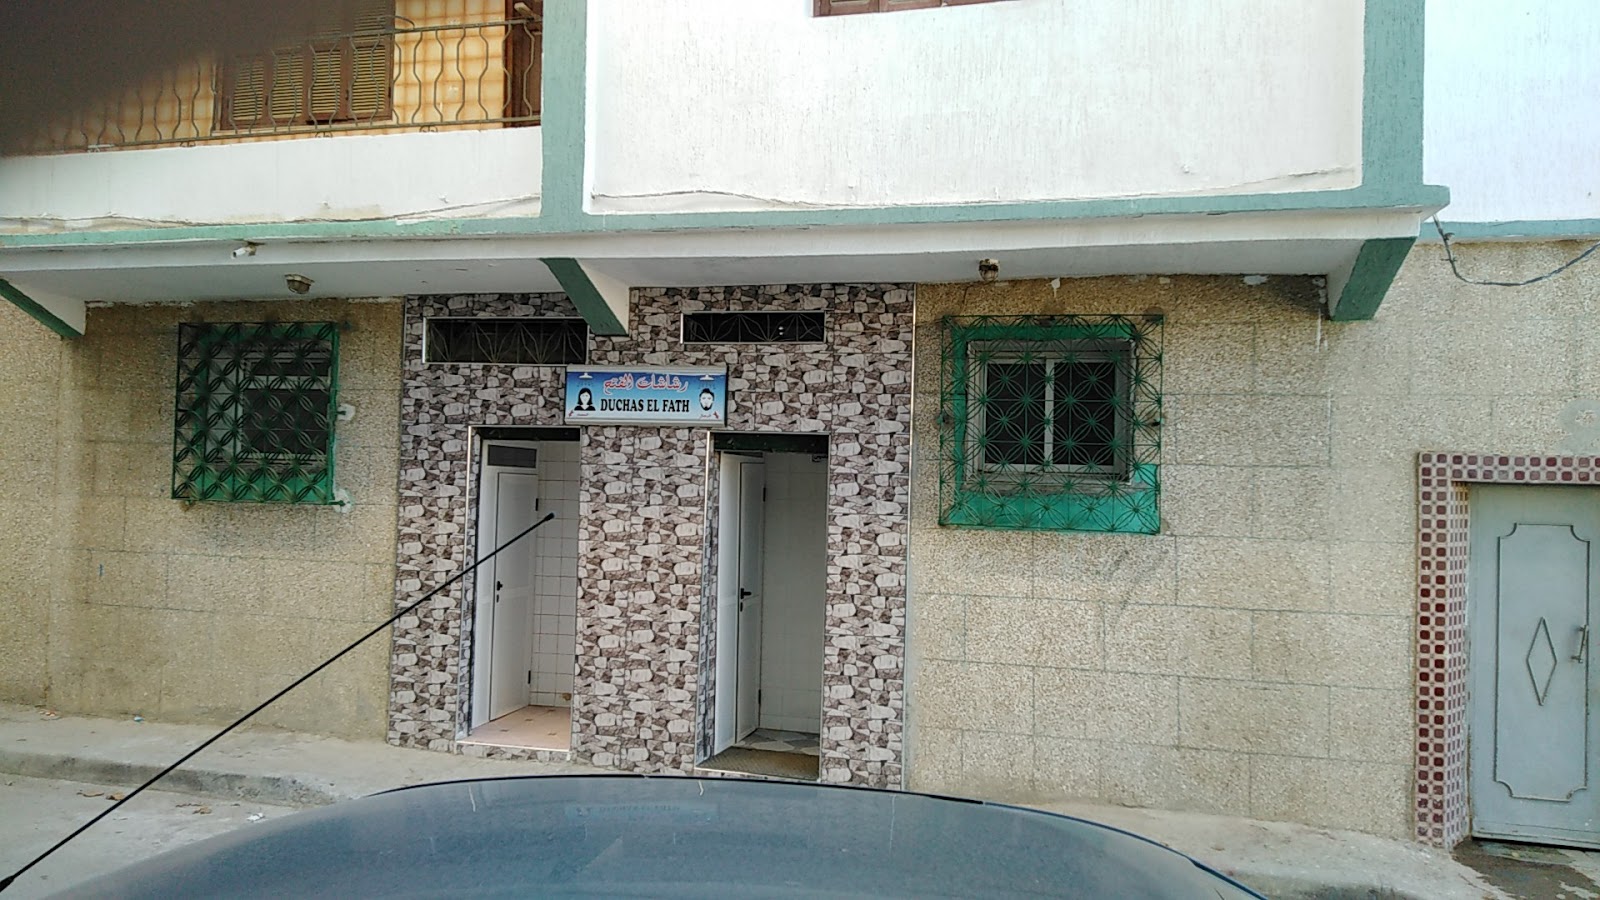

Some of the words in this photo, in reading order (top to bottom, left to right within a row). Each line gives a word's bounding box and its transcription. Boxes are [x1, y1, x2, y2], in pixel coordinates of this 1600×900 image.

[603, 373, 634, 395] الفتح
[636, 373, 689, 392] رشاشات
[600, 398, 645, 412] DUCHAS
[647, 399, 660, 412] EL
[662, 399, 690, 412] FATH
